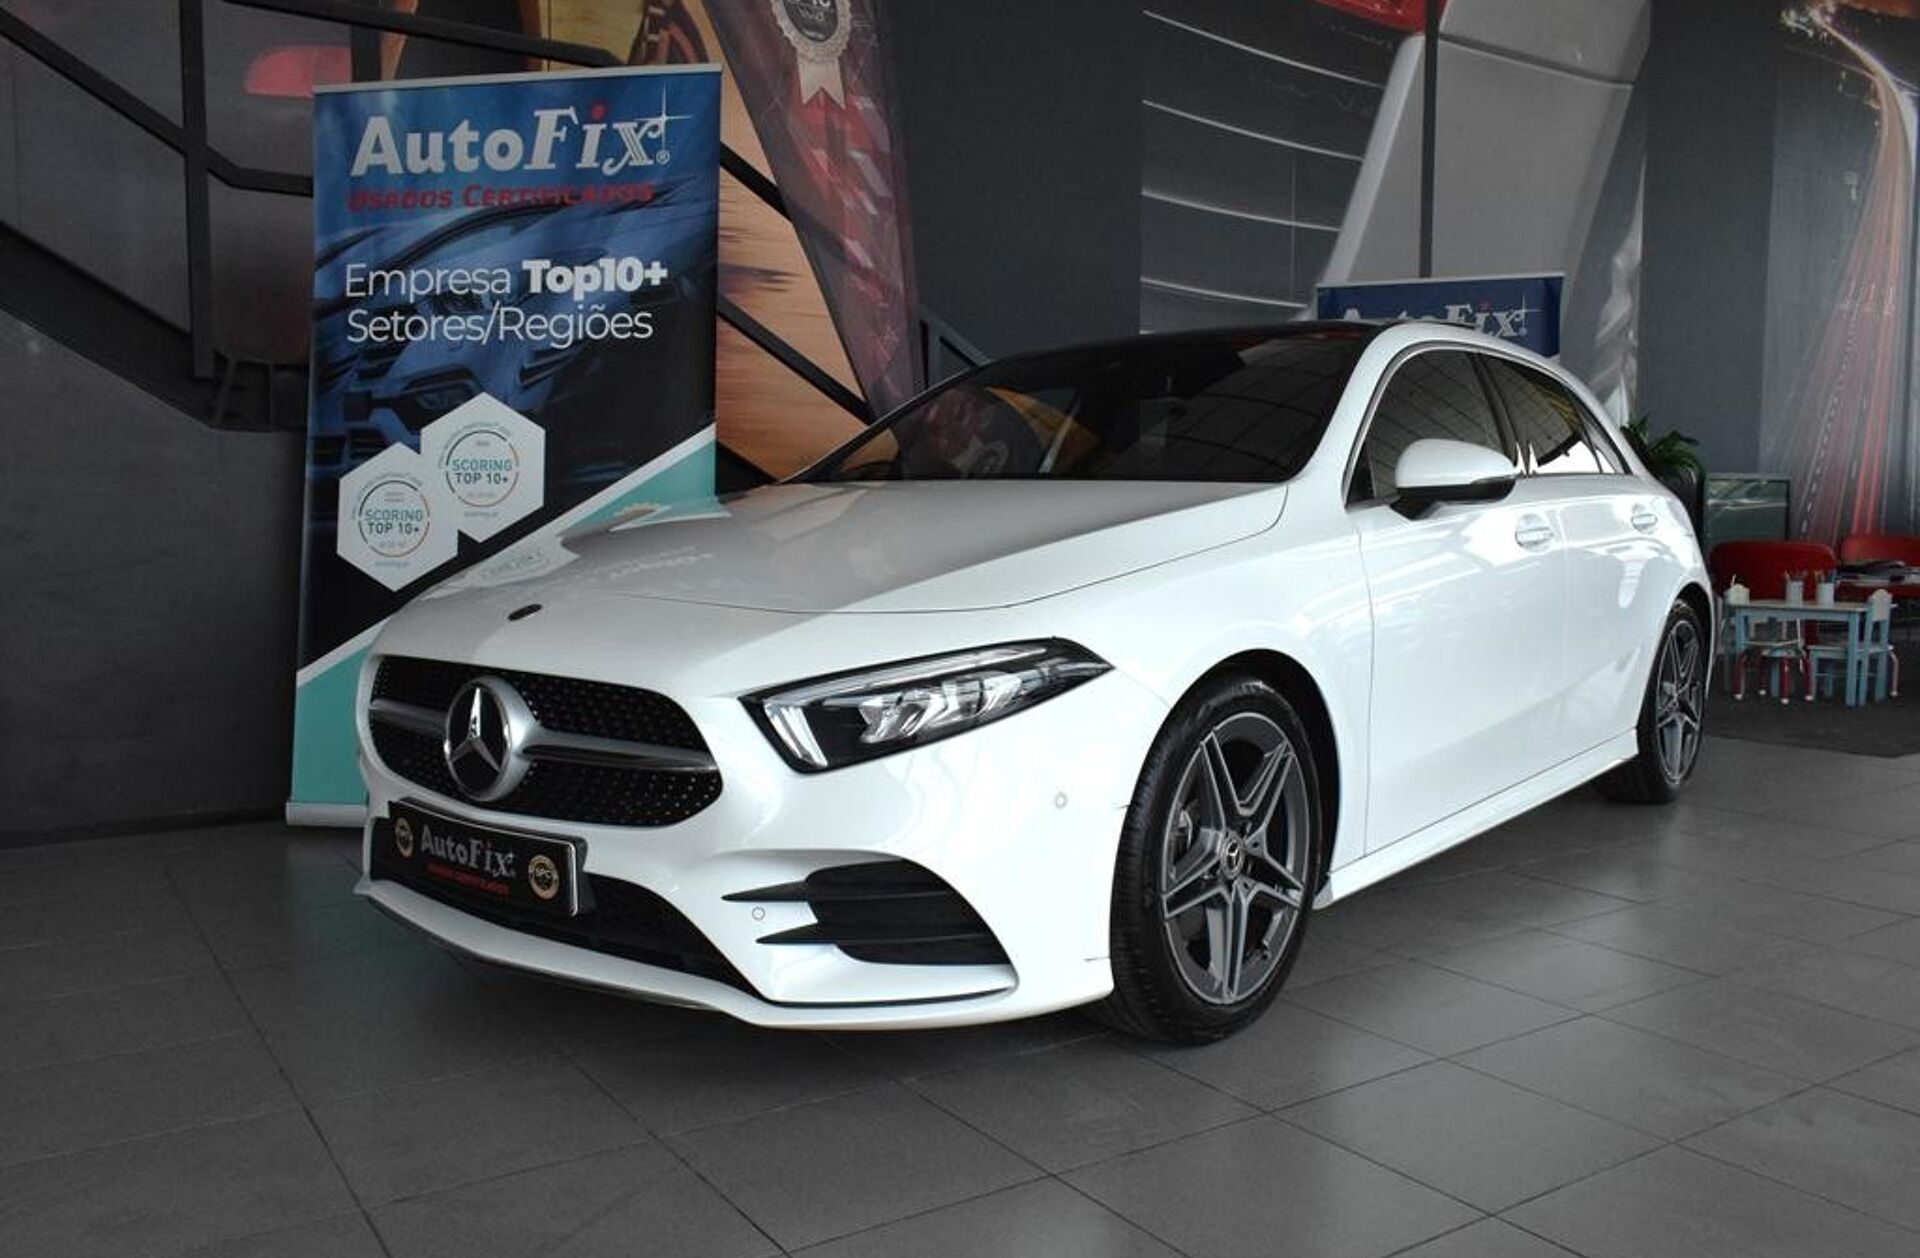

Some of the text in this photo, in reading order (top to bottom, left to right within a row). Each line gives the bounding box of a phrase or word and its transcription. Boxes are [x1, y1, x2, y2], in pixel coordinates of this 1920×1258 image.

[345, 256, 669, 303] Empresa Top10+
[346, 301, 654, 349] Setores/Regiões
[452, 458, 513, 472] SCORING
[454, 472, 509, 485] TOP 10+
[365, 508, 424, 522] SCORING
[367, 522, 393, 535] TOP
